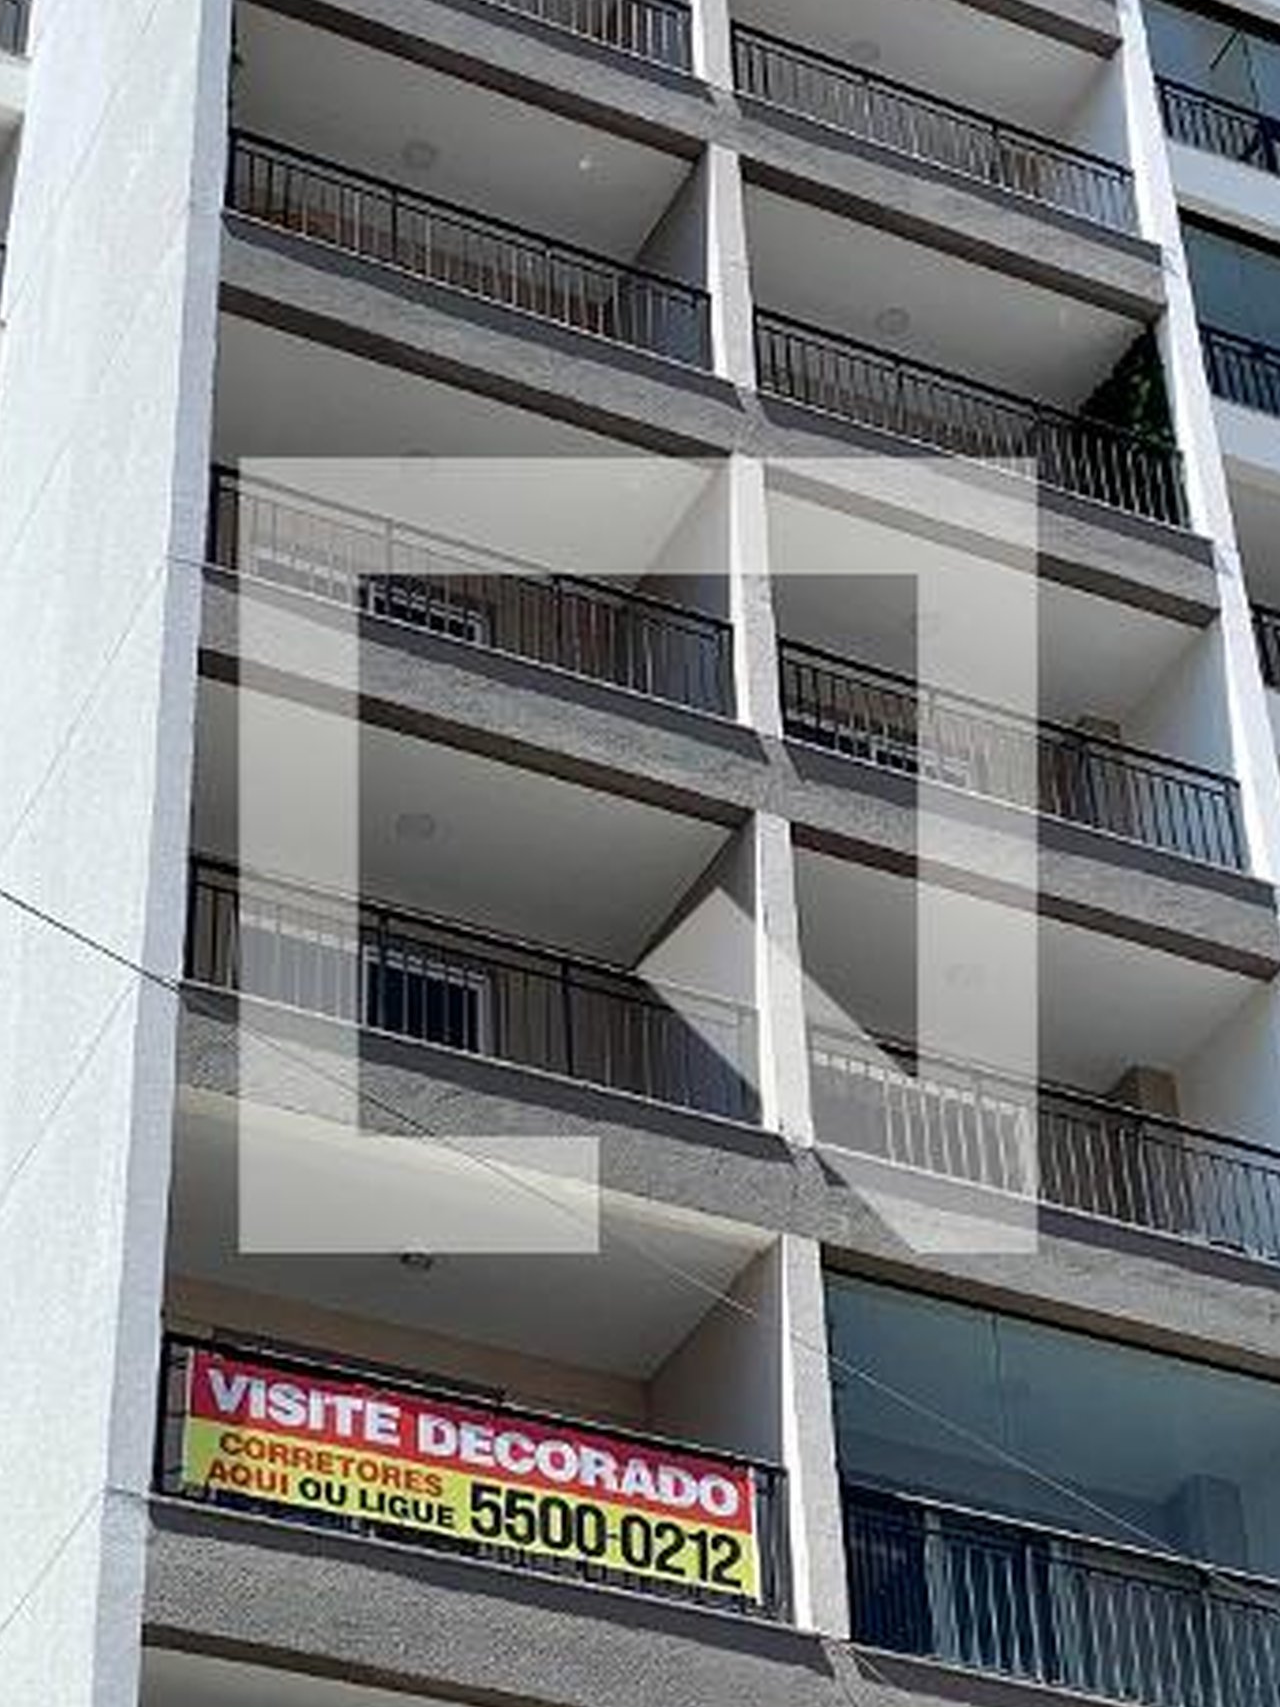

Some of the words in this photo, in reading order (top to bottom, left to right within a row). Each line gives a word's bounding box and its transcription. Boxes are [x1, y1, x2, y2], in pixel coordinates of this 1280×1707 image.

[208, 1368, 402, 1448] VISITE
[419, 1414, 741, 1518] DECORADO
[219, 1431, 445, 1498] CORRETORES
[208, 1459, 289, 1496] AQUI
[298, 1477, 349, 1508] OU
[359, 1491, 455, 1531] LIGUE
[470, 1480, 743, 1588] 5500-0212
